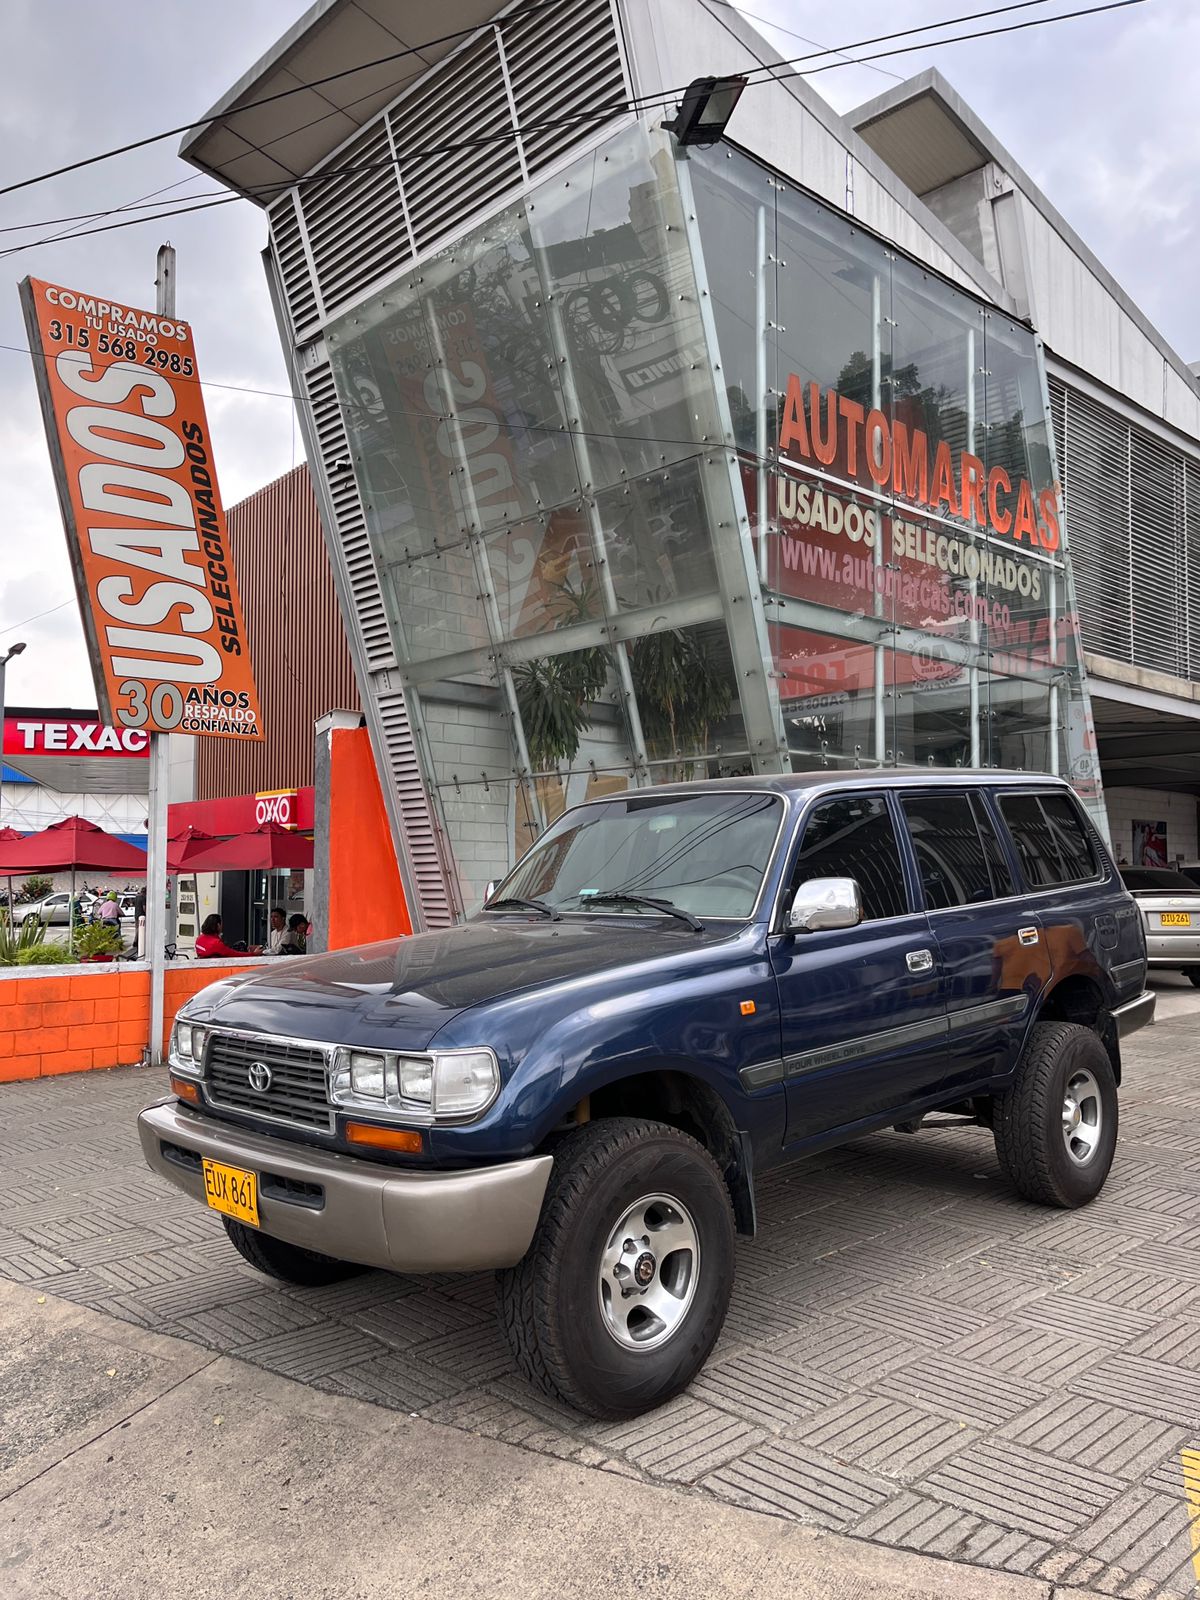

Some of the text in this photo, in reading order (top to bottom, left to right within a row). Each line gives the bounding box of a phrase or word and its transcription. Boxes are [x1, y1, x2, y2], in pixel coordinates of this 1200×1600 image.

[45, 287, 188, 342] COMPRAMOS
[84, 315, 158, 346] TU USADO
[49, 320, 194, 377] 315 568 2985
[779, 372, 1061, 553] AUTOMARCAS
[55, 349, 223, 684] USADOS
[181, 420, 242, 657] SELECCINADOS
[778, 478, 1042, 600] USADOS SELECCIONADOS
[781, 538, 1010, 631] www.automarcas.com.co
[116, 679, 249, 730] 30 AÑOS
[181, 718, 259, 736] CONFIANZA
[184, 704, 256, 723] RESPALDO
[17, 722, 147, 751] TEXAC
[255, 795, 290, 825] OXXO
[1176, 914, 1189, 923] 261
[789, 1057, 813, 1072] FOUR
[813, 1051, 842, 1067] WHEEL
[205, 1168, 254, 1211] EUX 861
